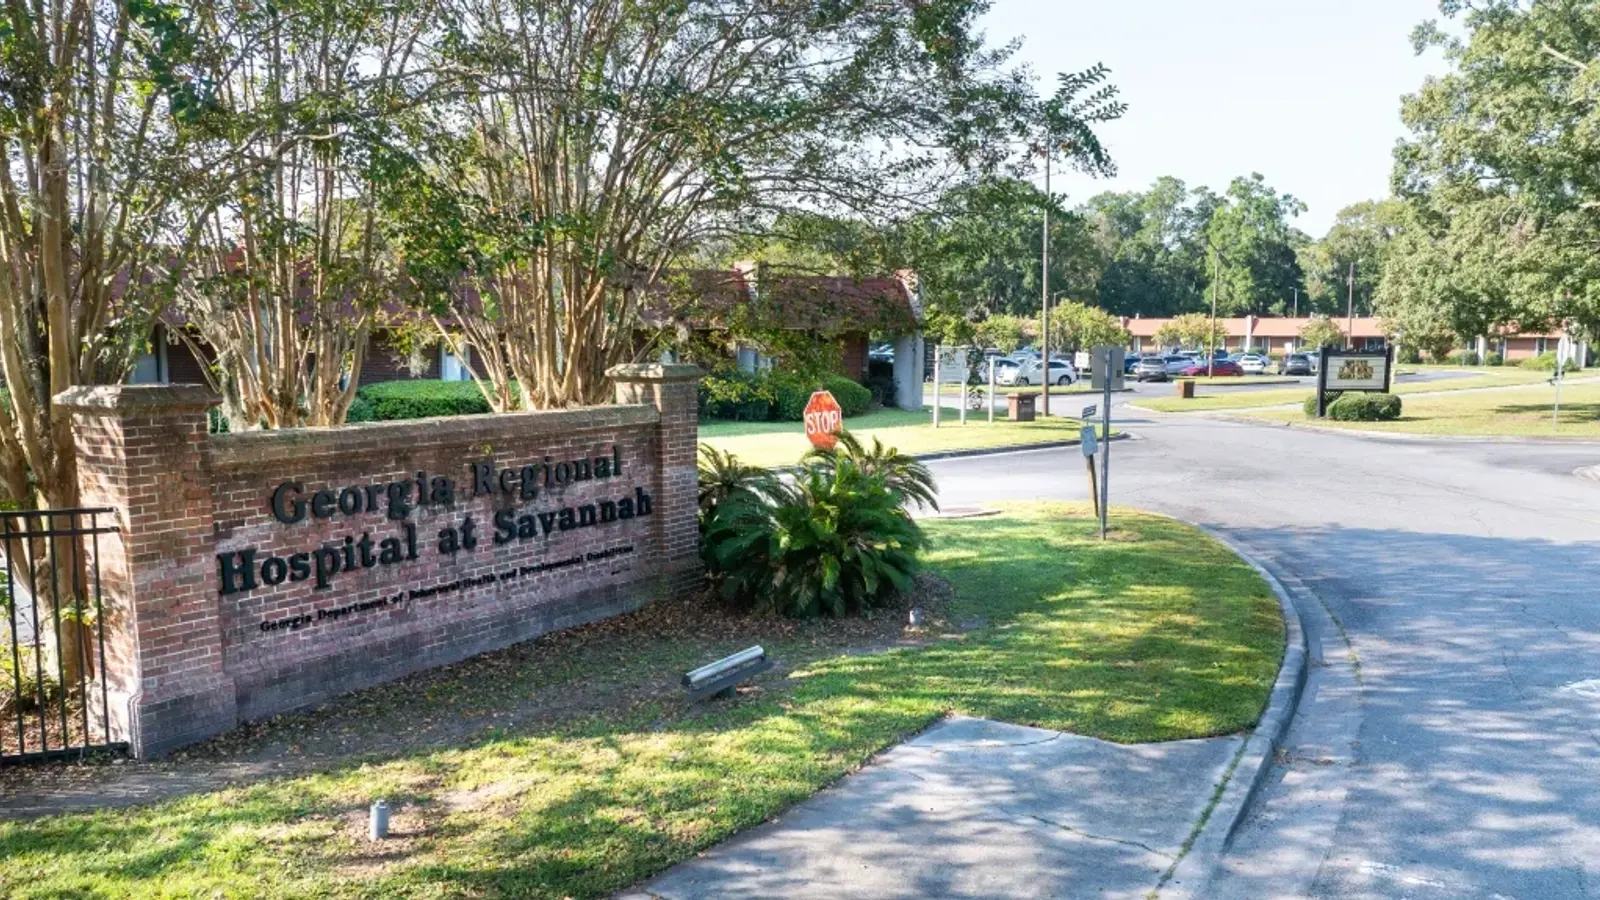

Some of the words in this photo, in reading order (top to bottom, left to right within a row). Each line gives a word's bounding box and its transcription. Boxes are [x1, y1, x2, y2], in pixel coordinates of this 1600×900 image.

[806, 411, 839, 434] STOP
[272, 471, 454, 524] Georgia
[471, 445, 622, 500] Regional
[217, 523, 419, 595] Hospital
[438, 516, 477, 554] at
[494, 487, 652, 545] Savannah
[260, 614, 313, 633] Georgia
[317, 598, 388, 620] Department
[391, 591, 404, 605] of
[463, 573, 496, 591] Health
[500, 568, 517, 581] and
